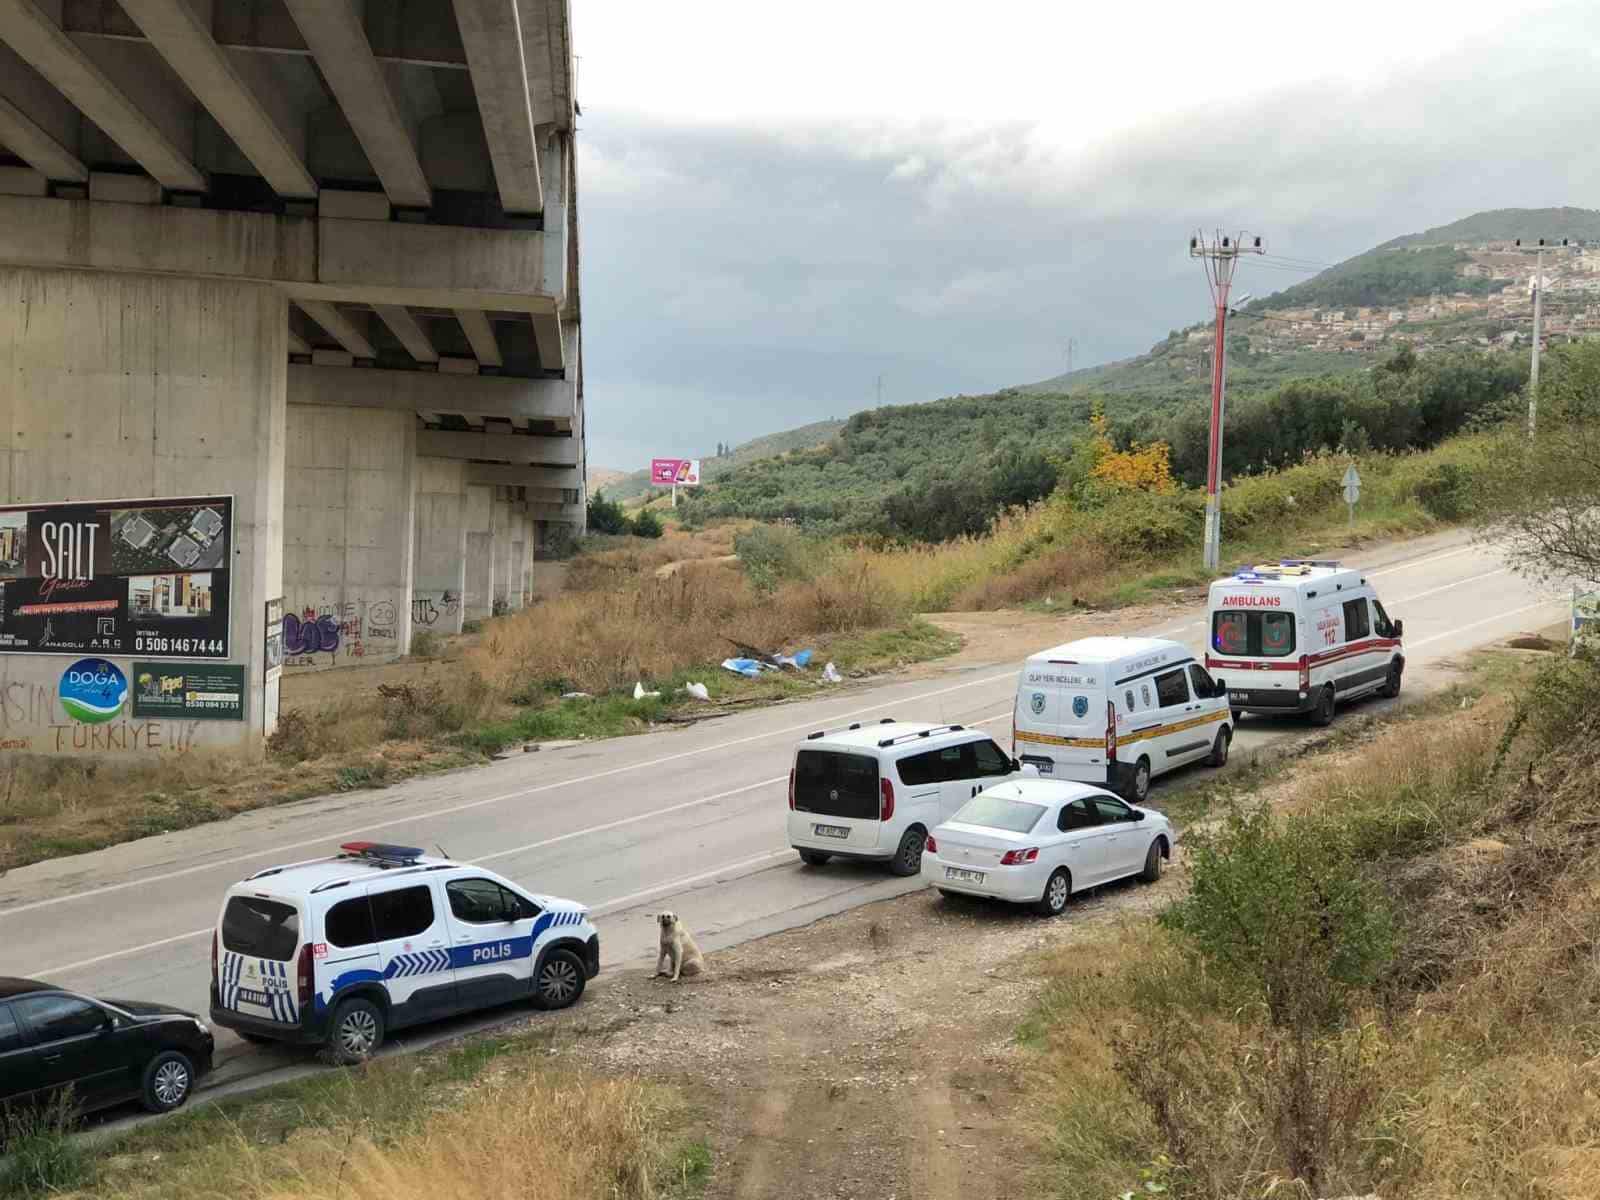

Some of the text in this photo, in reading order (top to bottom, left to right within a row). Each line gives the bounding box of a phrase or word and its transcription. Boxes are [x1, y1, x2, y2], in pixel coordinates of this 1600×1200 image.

[41, 521, 100, 580] SALT
[1222, 596, 1281, 607] AMBULANS
[44, 641, 84, 649] ANADOLU
[135, 637, 223, 653] 0 506 146 74 44
[48, 720, 162, 752] TÜRKİYE
[473, 943, 512, 961] POLİS
